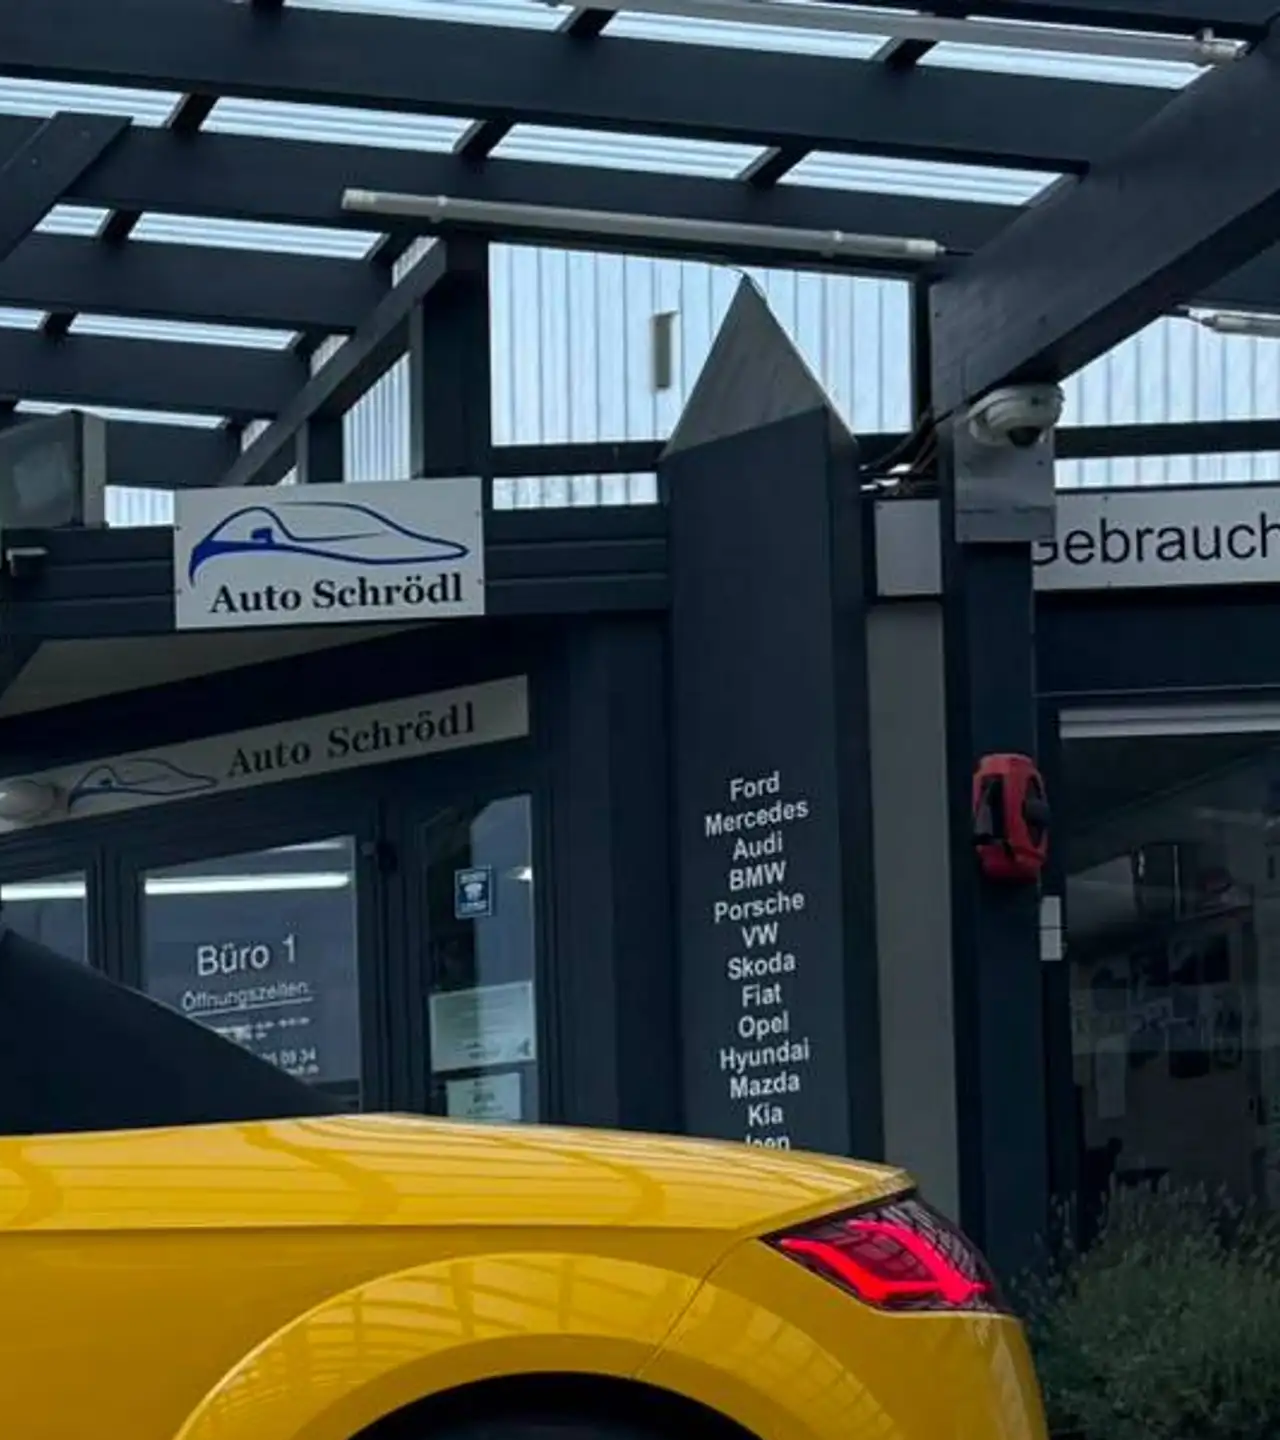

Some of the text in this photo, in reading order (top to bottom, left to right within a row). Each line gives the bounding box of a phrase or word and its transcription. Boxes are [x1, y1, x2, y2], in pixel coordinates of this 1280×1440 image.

[209, 573, 464, 615] Auto Schrödl
[226, 702, 476, 779] Auto Schrödl
[729, 769, 781, 801] Ford
[704, 800, 810, 838] Mercedes
[732, 830, 784, 861] Audi
[728, 861, 787, 892] BMW
[713, 890, 805, 924] Porsche
[741, 922, 779, 949] VW
[197, 933, 296, 976] Büro 1
[727, 952, 796, 981] Skoda
[742, 984, 782, 1007] Fiat
[738, 1010, 790, 1041] Opel
[719, 1037, 810, 1073] Hyundai
[729, 1069, 801, 1099] Mazda
[748, 1102, 784, 1127] Kia
